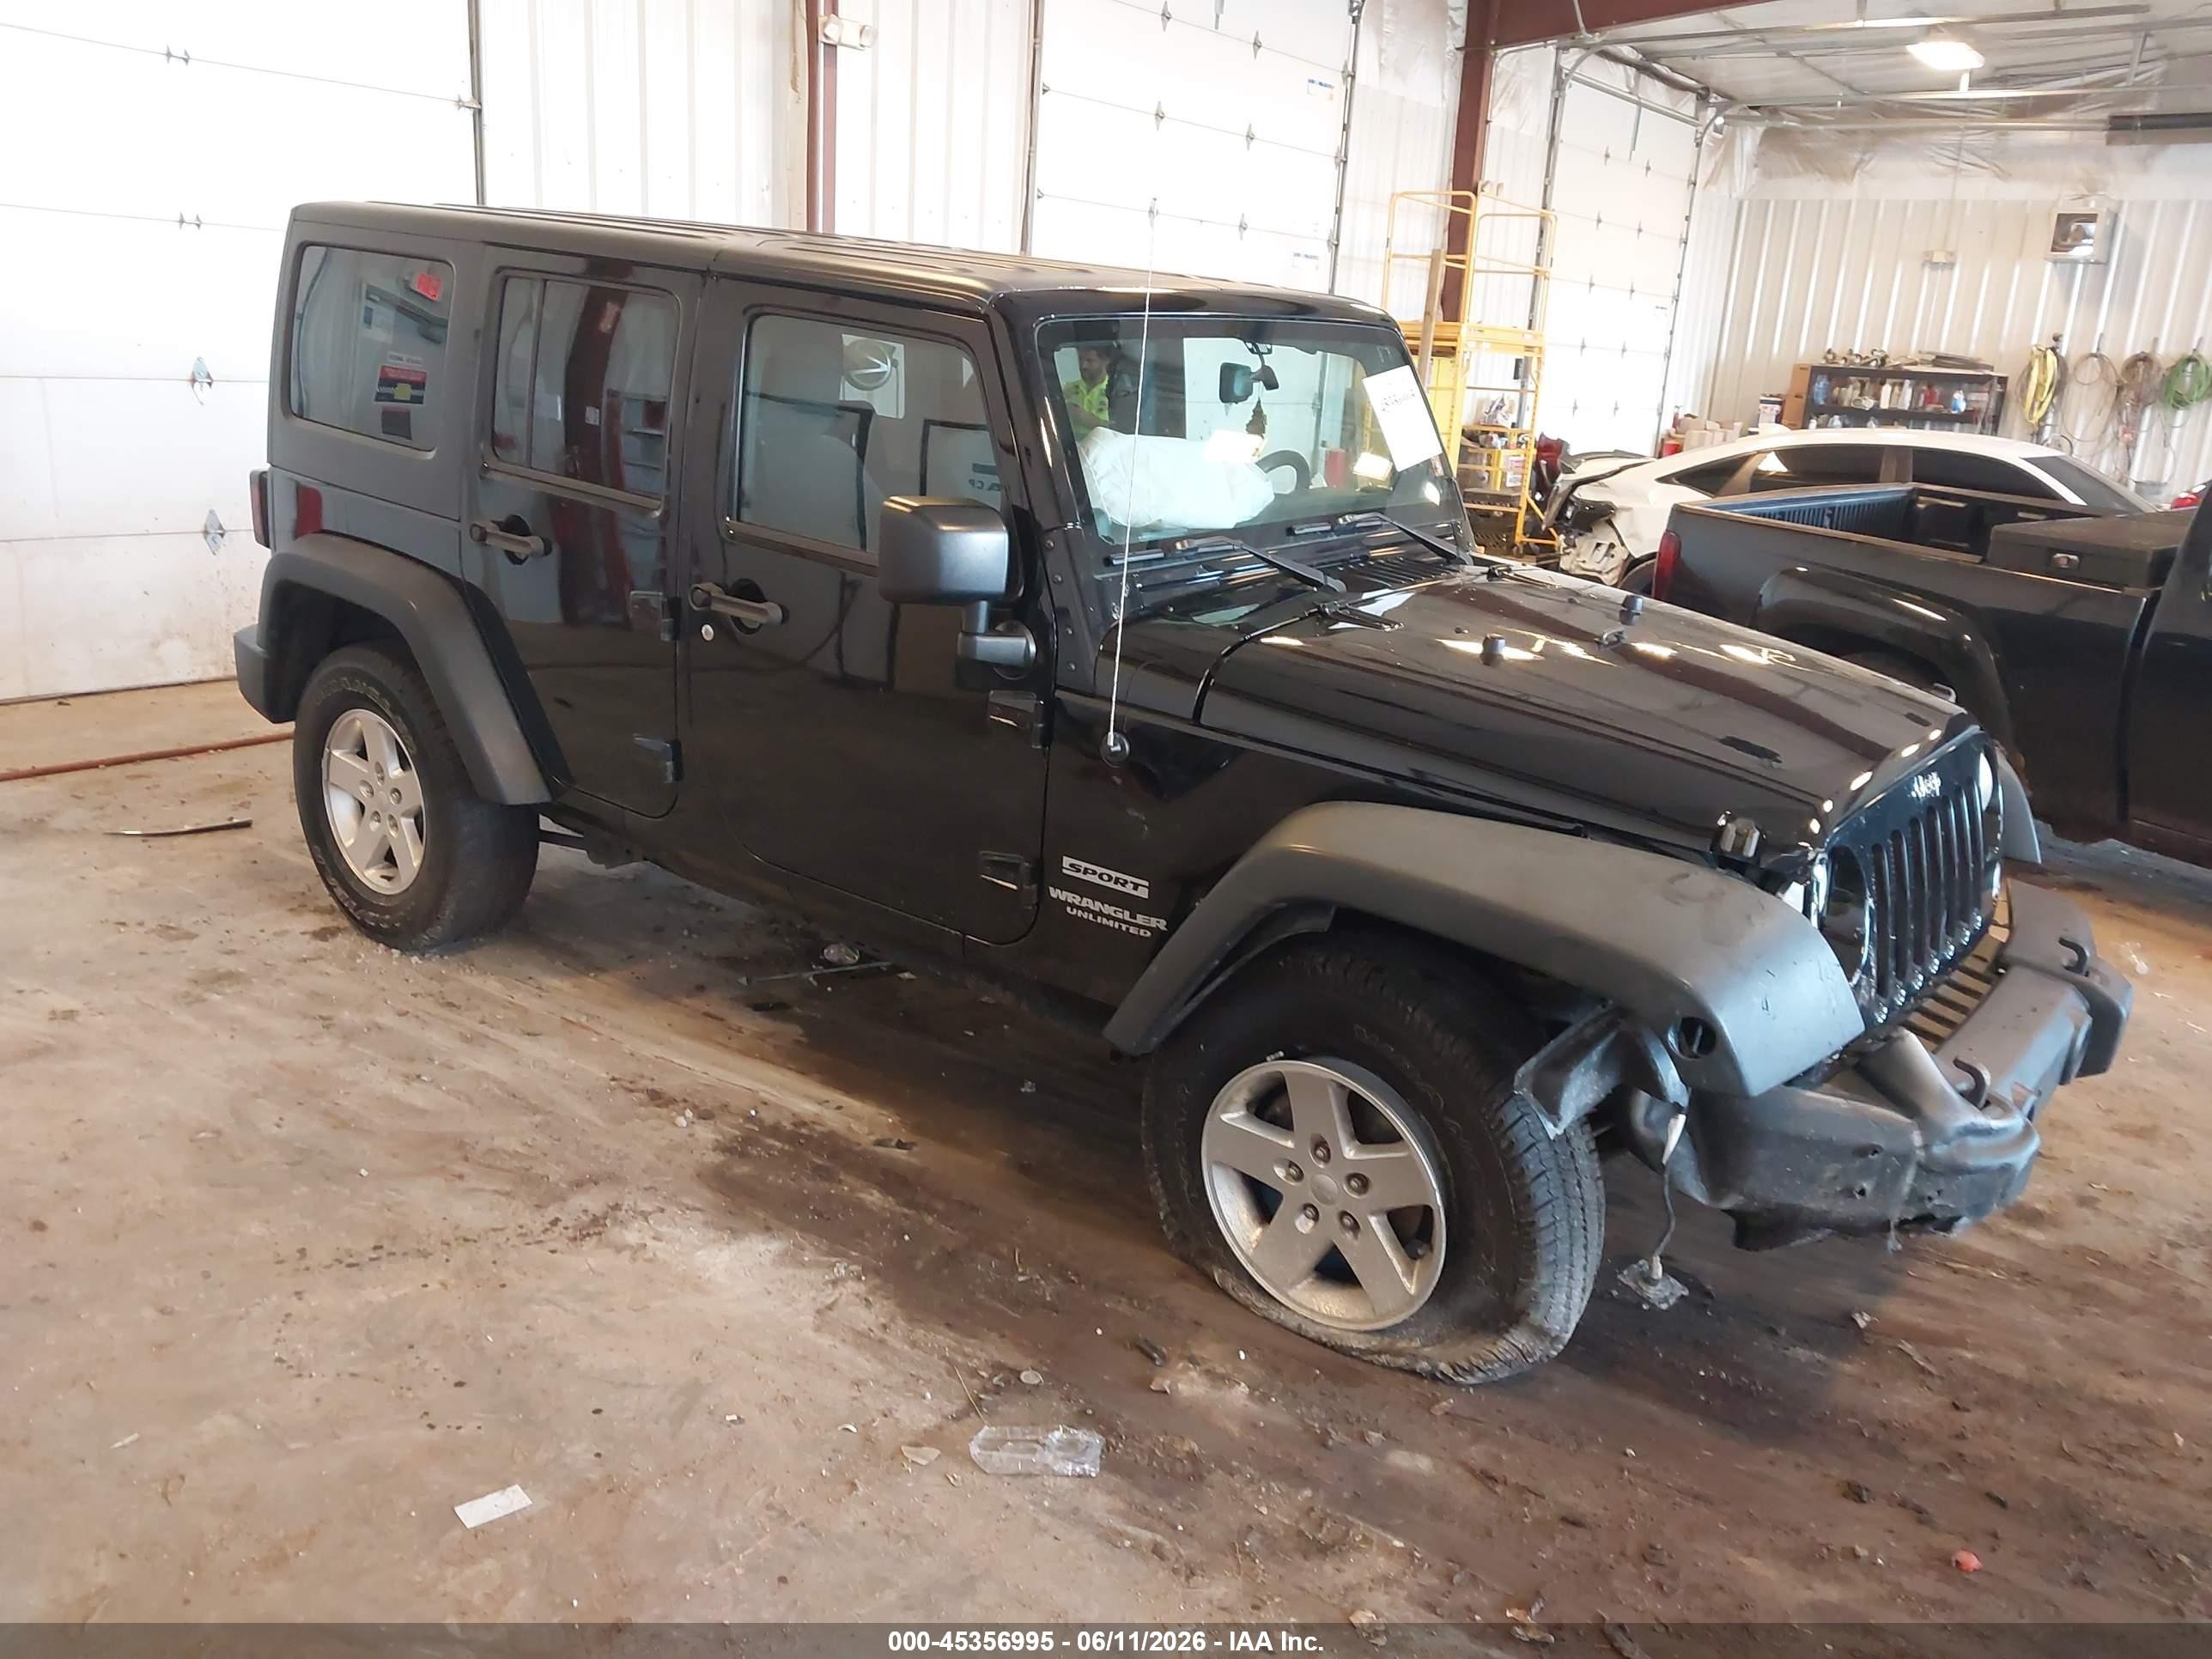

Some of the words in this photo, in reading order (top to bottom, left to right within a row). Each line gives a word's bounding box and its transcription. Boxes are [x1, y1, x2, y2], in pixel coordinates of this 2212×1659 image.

[1065, 861, 1150, 892] SPORT
[1048, 885, 1168, 931] WRANGLER
[1066, 905, 1152, 937] UNLIMITED
